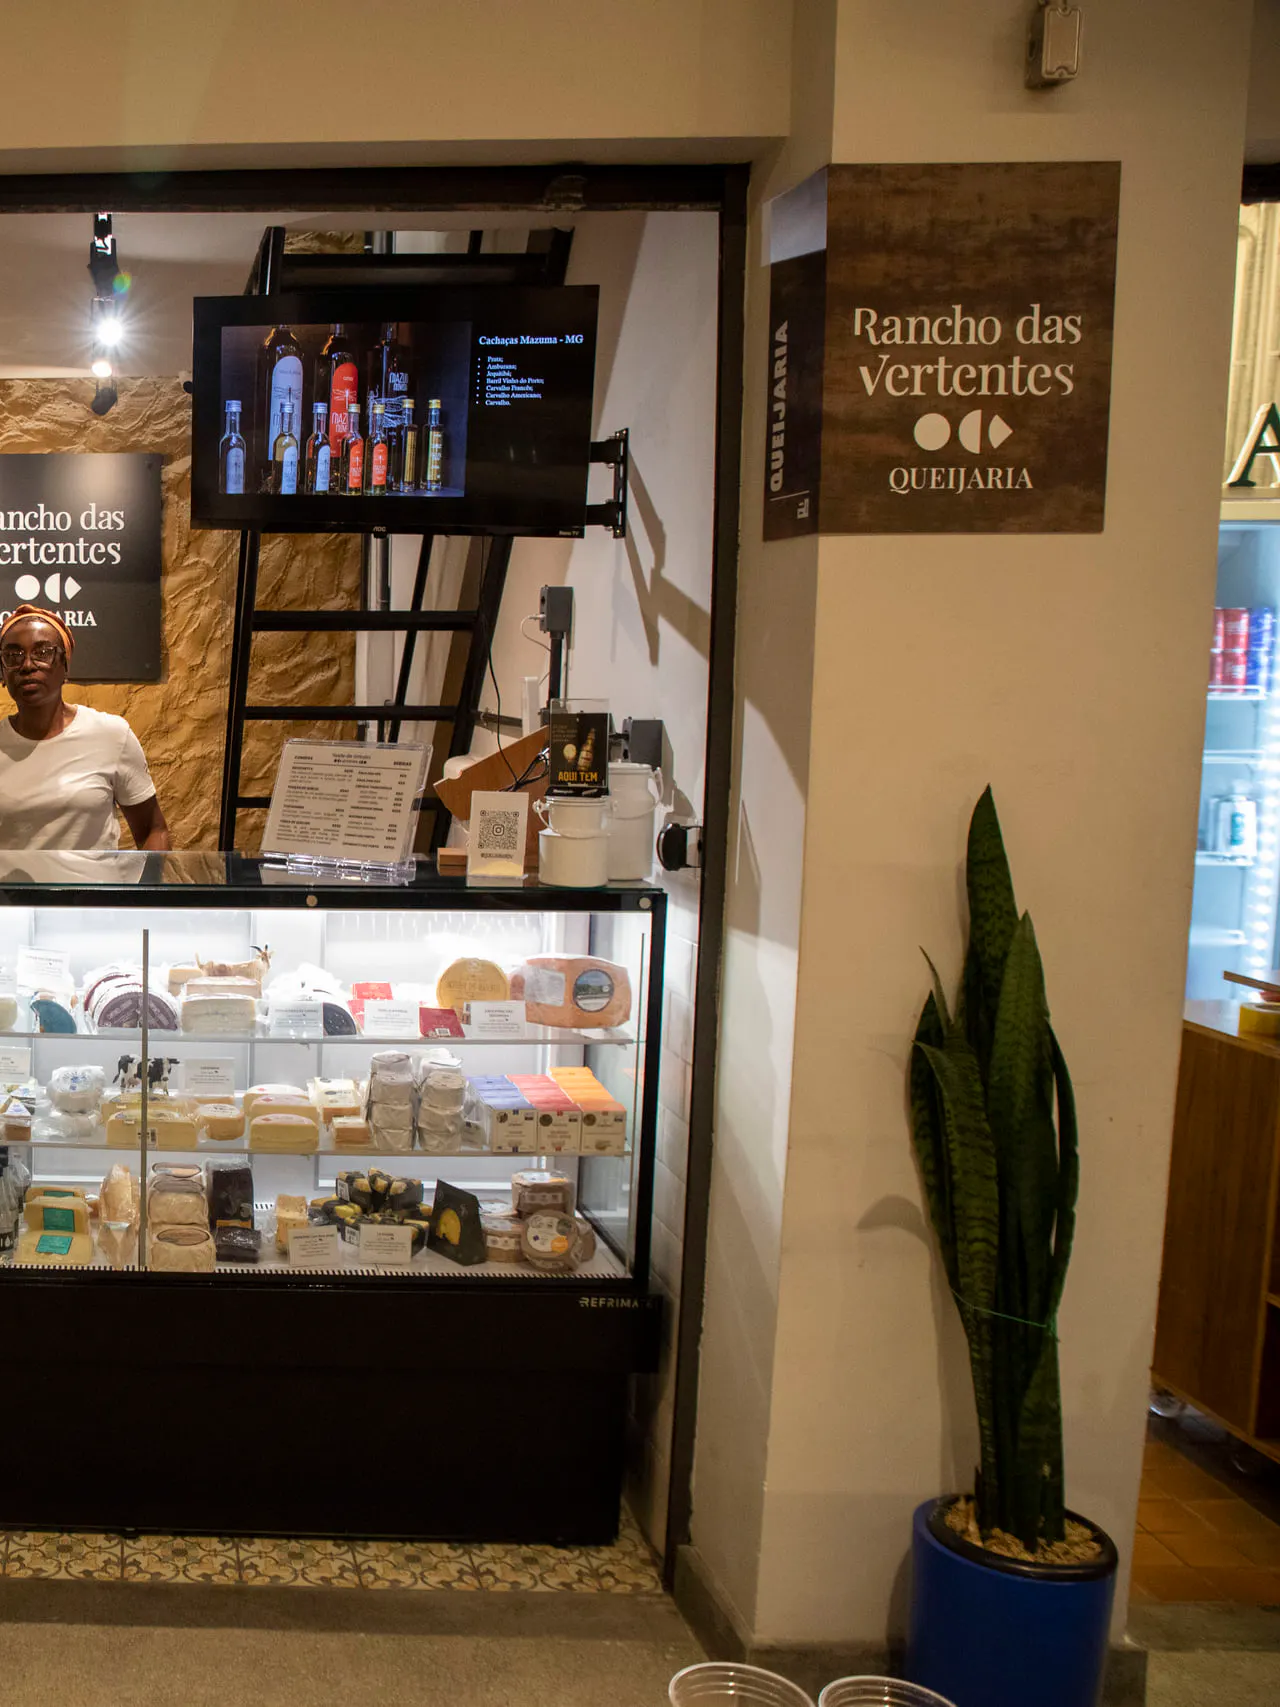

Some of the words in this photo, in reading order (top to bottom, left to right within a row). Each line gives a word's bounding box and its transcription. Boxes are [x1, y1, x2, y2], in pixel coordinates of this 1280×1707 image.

[854, 303, 1003, 346] Rancho
[1015, 303, 1083, 345] das
[478, 335, 519, 346] Cachaças
[519, 335, 558, 345] Mazuma
[564, 334, 584, 344] MG
[859, 354, 1075, 397] Vertentes
[770, 320, 789, 492] QUEIJARIA
[888, 467, 1033, 494] QUEIJARIA
[80, 503, 125, 530] das
[558, 771, 578, 782] AQUI
[579, 771, 598, 782] TEM
